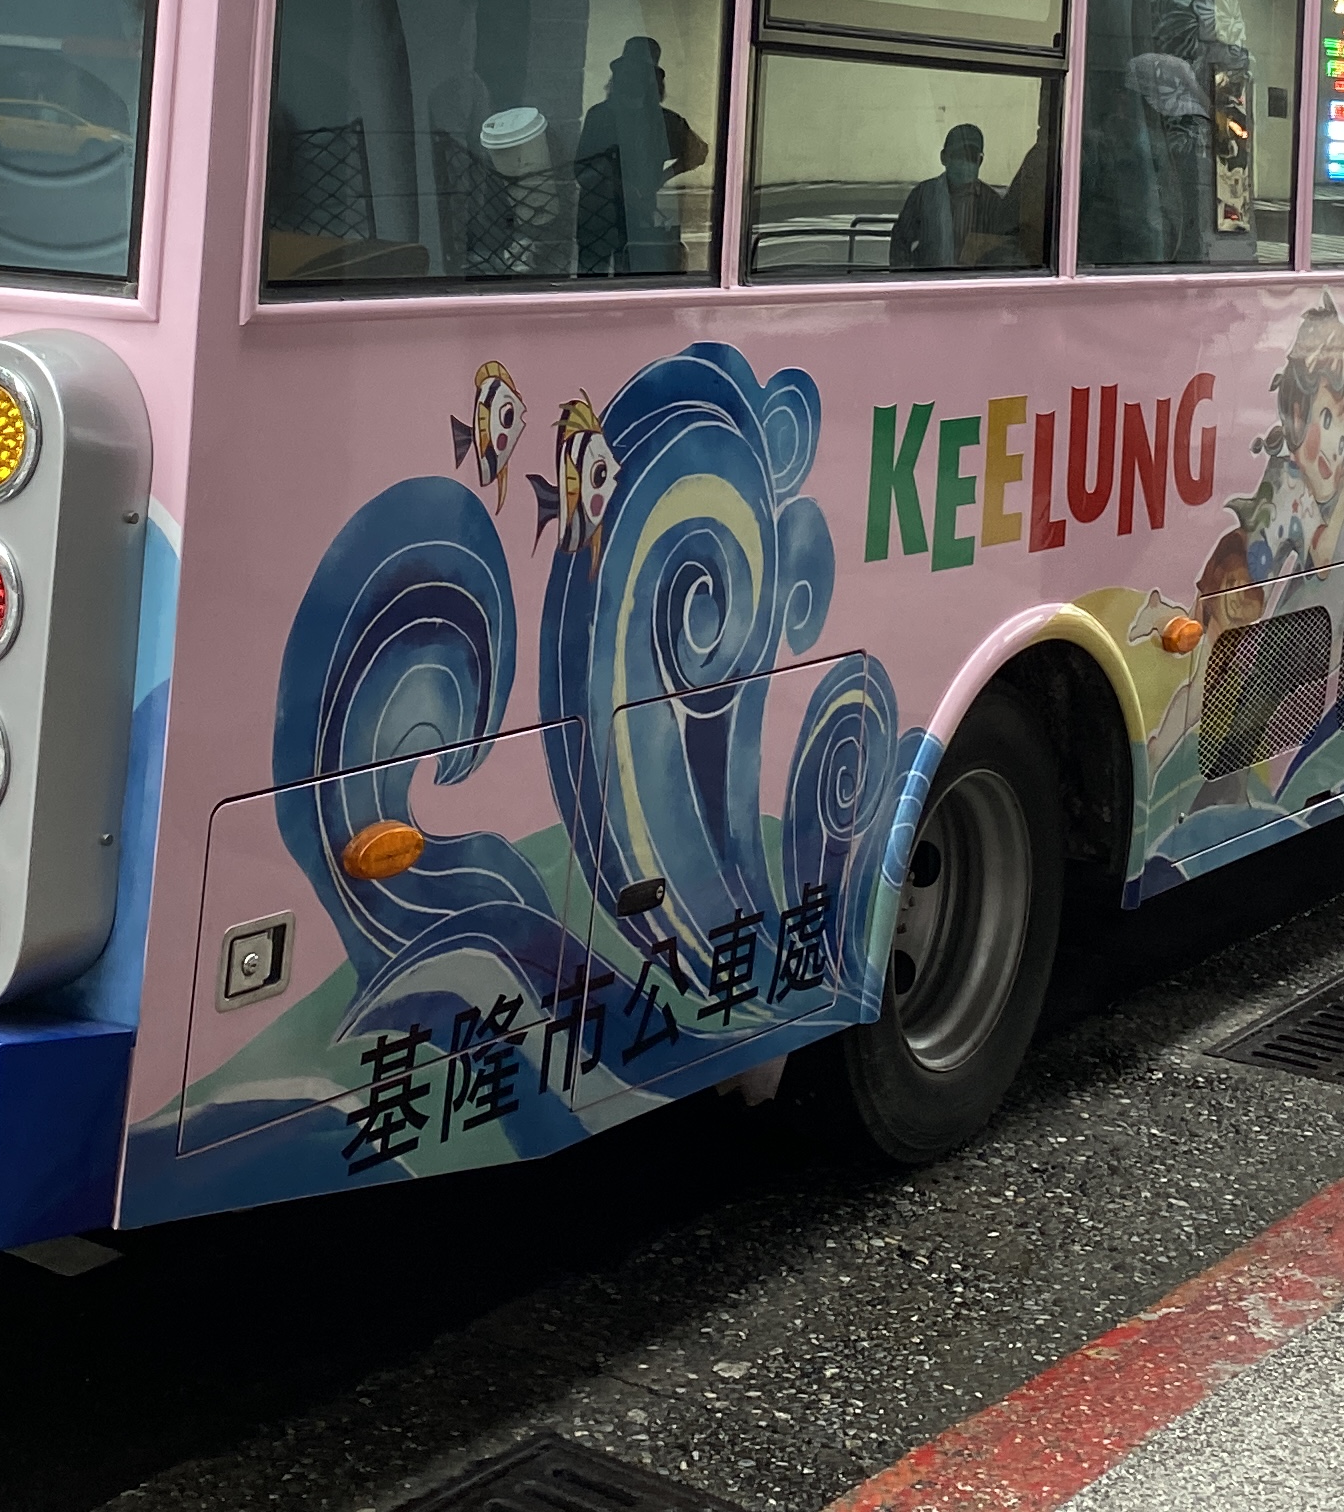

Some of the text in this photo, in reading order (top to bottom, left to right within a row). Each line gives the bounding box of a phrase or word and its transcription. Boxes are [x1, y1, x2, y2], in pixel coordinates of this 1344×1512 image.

[863, 372, 1217, 573] KEELUNG
[340, 882, 833, 1177] 基隆市公車處
